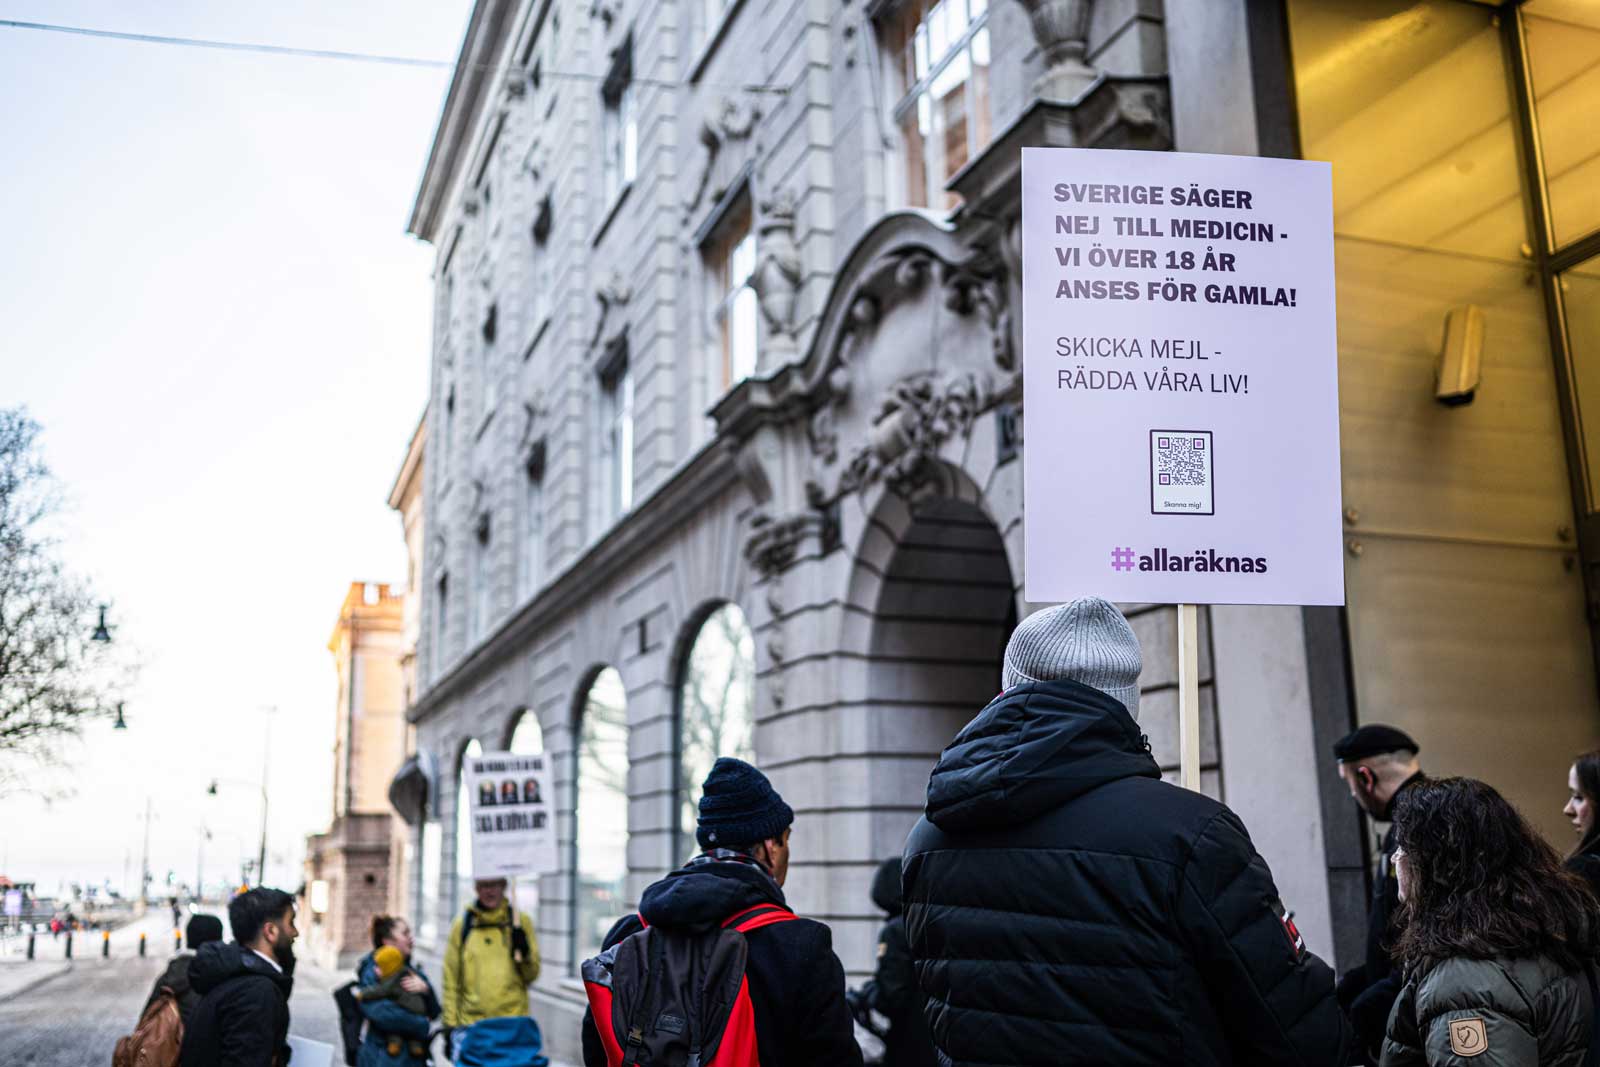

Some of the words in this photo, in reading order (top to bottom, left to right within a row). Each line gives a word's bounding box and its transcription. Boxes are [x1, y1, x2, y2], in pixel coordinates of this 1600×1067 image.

[1054, 183, 1164, 205] SVERIGE
[1170, 183, 1253, 209] SÄGER
[1055, 215, 1100, 235] NEJ
[1113, 216, 1164, 237] TILL
[1055, 247, 1080, 267] VI
[1088, 243, 1157, 268] ÖVER
[1165, 250, 1195, 270] 18
[1202, 246, 1236, 272] ÅR
[1055, 279, 1140, 300] ANSES
[1147, 277, 1197, 302] FÖR
[1204, 284, 1297, 307] GAMLA!
[1056, 337, 1143, 358] SKICKA
[1057, 366, 1137, 391] RÄDDA
[1143, 366, 1203, 392] VÅRA
[1210, 373, 1249, 394] LIV!
[1188, 501, 1202, 510] mig!
[1111, 546, 1268, 574] #allaräknas
